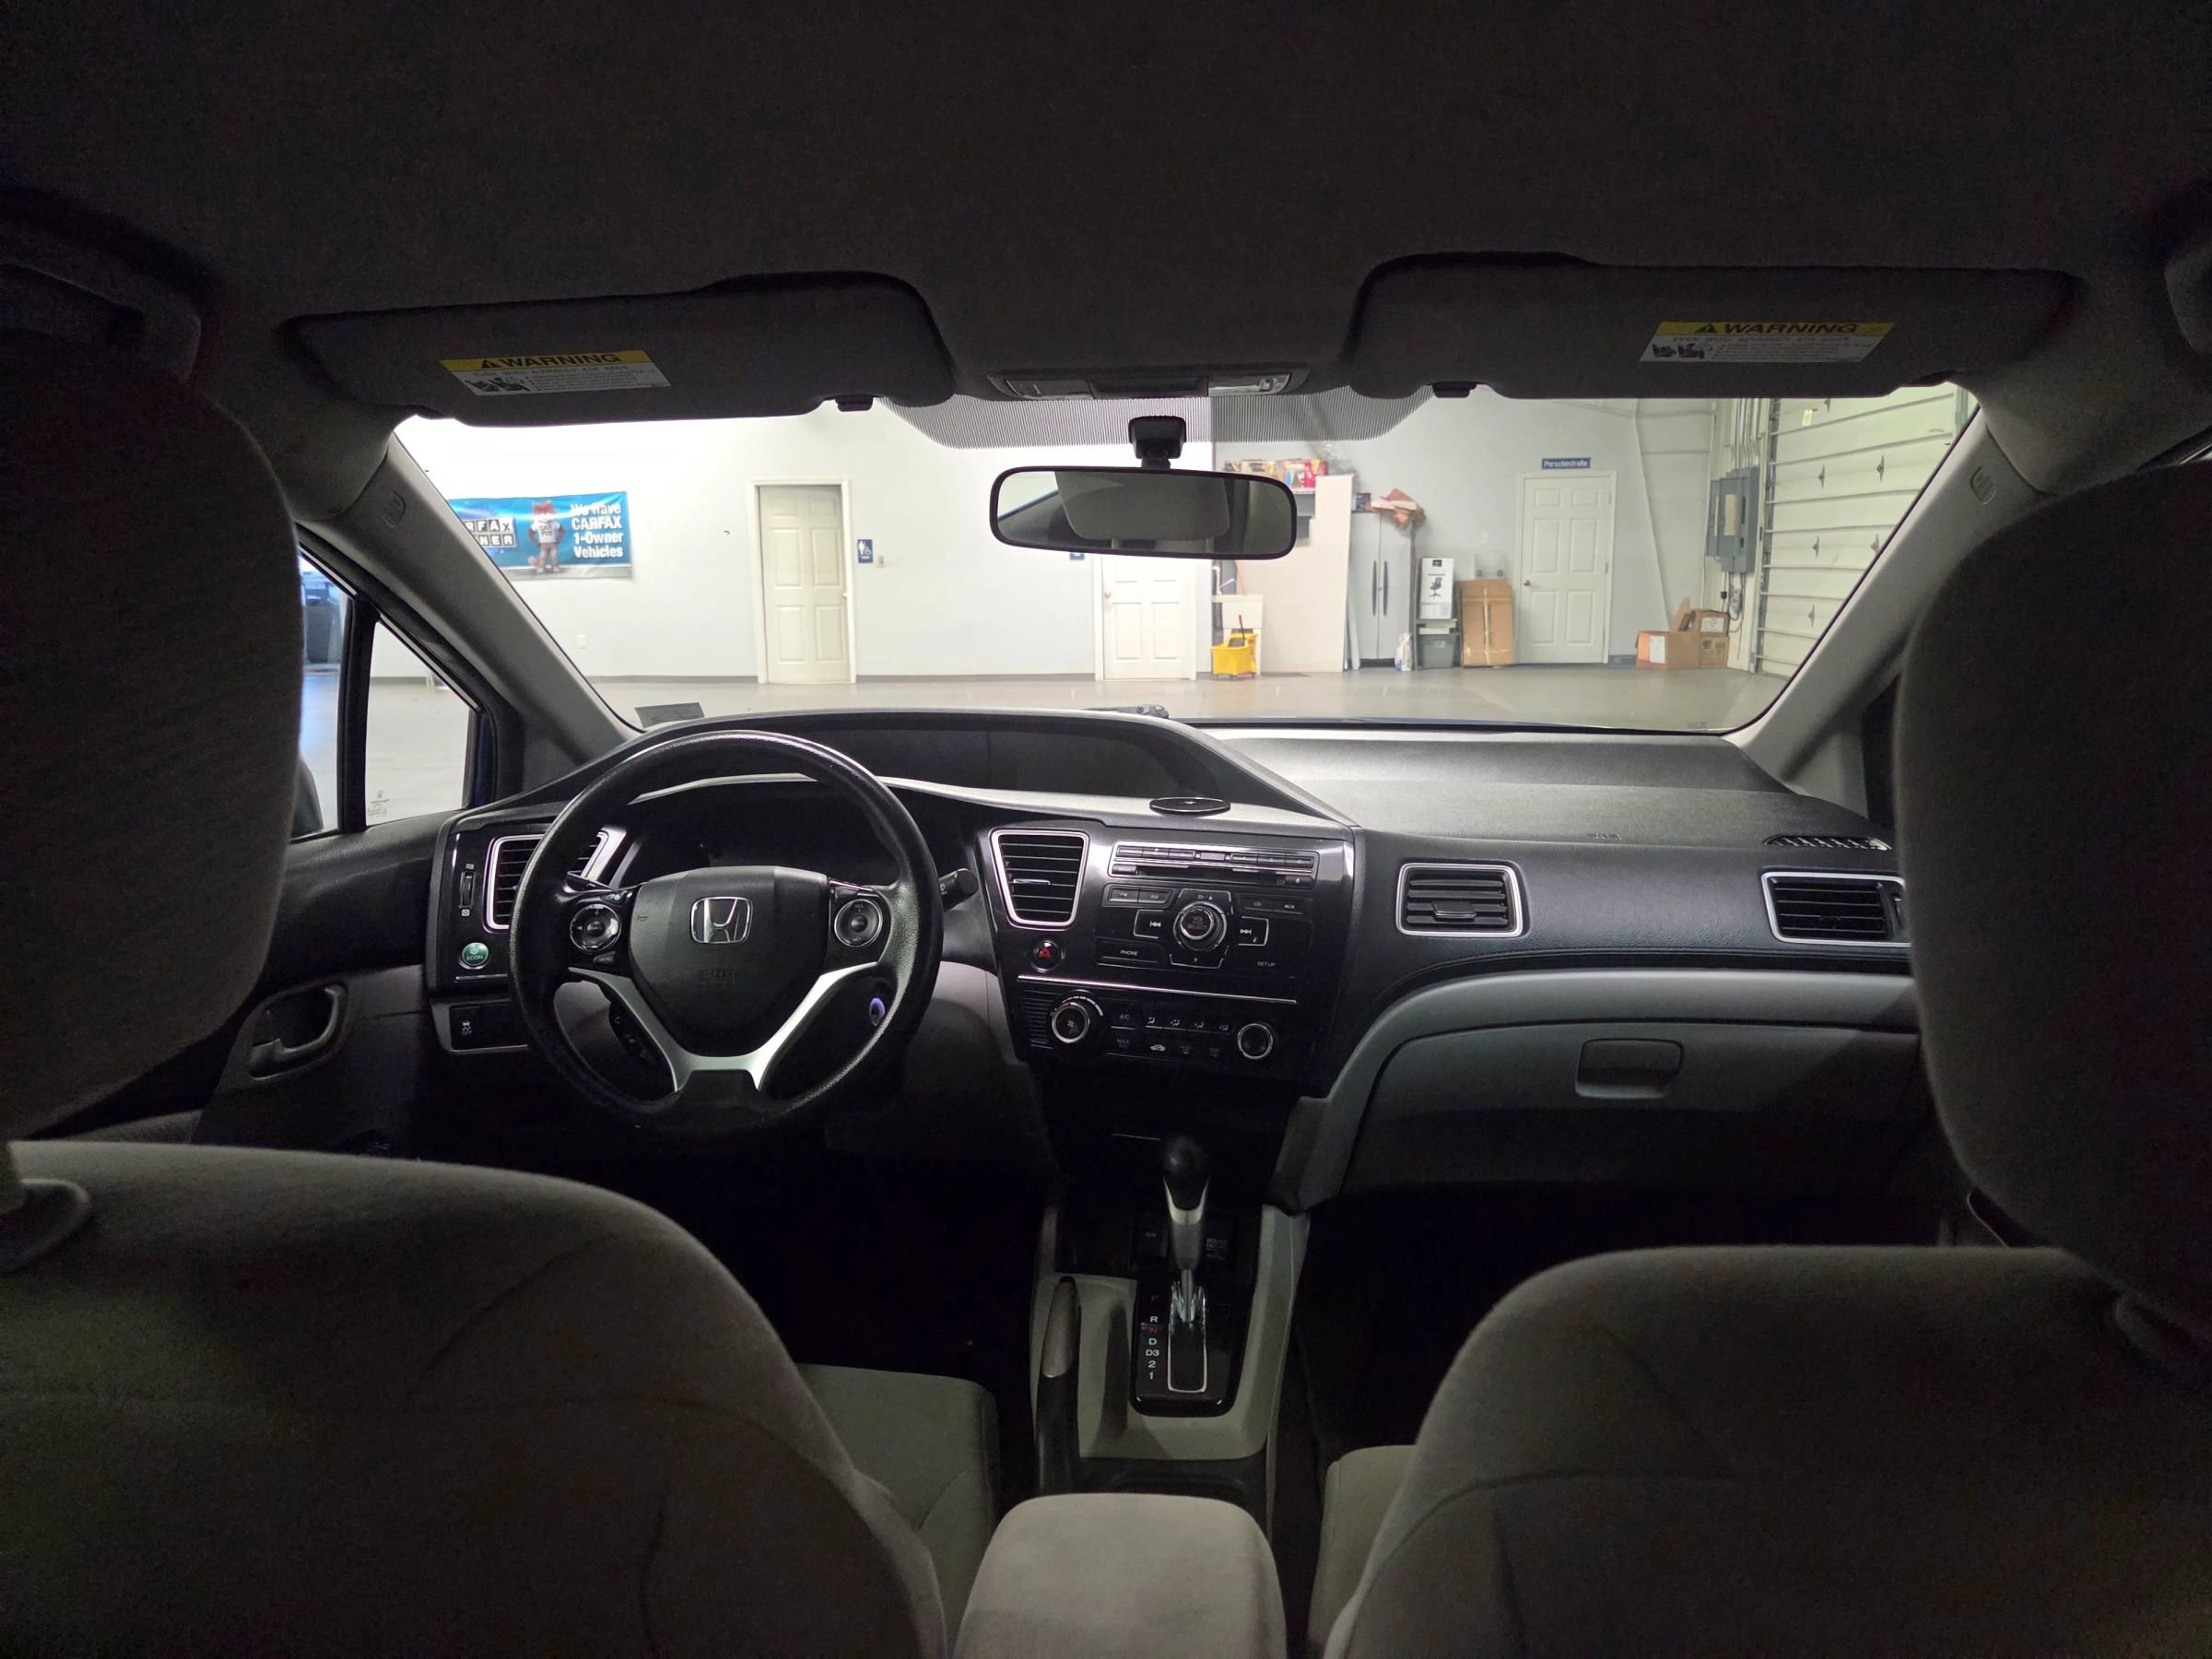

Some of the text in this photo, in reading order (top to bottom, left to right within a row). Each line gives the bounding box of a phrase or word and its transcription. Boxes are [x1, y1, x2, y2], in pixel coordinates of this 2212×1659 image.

[1724, 324, 1858, 334] WARNING
[499, 353, 621, 368] WARNING
[571, 516, 623, 531] CARFAX
[574, 531, 624, 545] 1-Owner
[573, 545, 624, 559] Vehicles
[1149, 1326, 1159, 1335] N
[1148, 1337, 1158, 1346] D
[1147, 1360, 1157, 1369] 2
